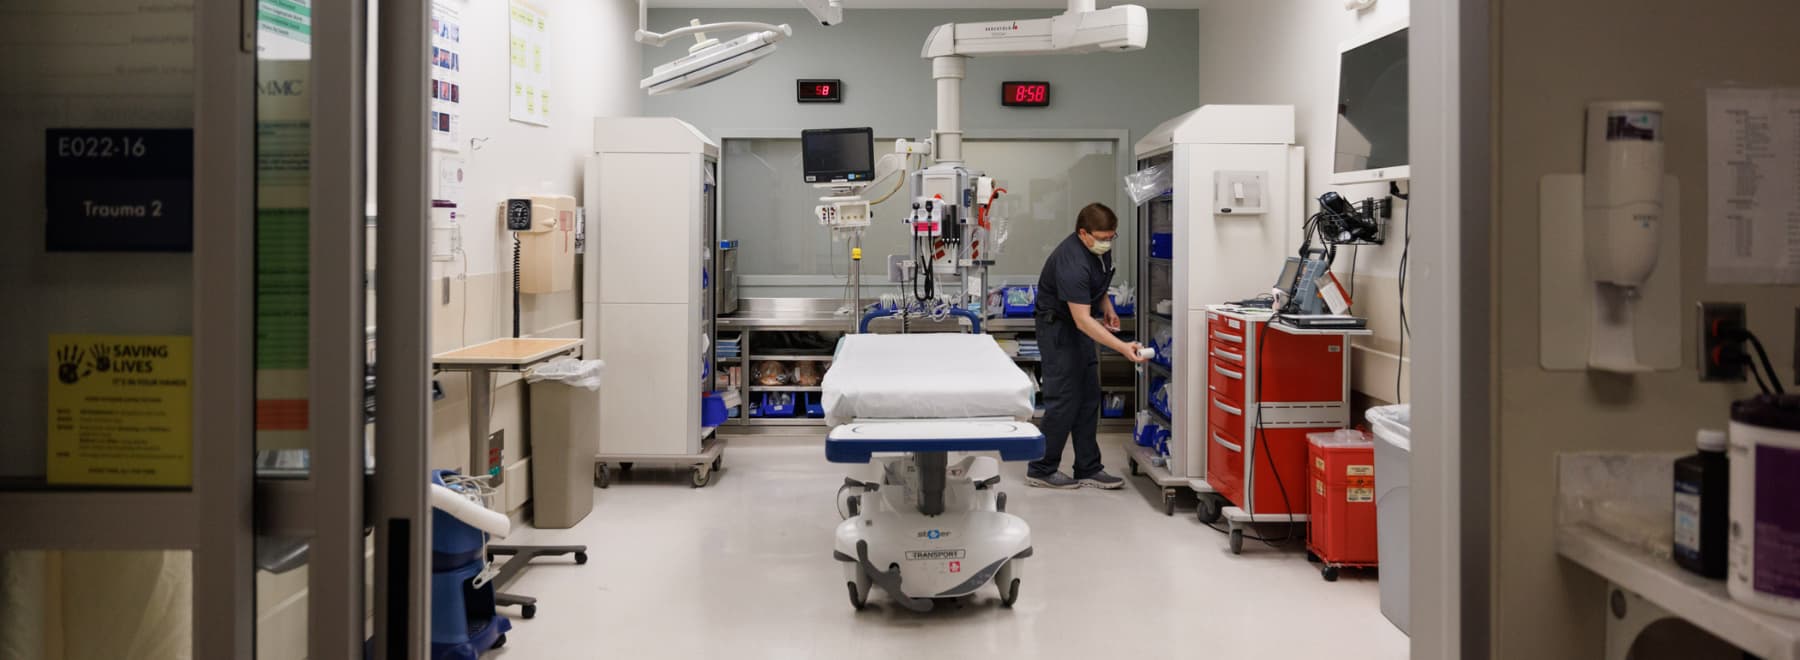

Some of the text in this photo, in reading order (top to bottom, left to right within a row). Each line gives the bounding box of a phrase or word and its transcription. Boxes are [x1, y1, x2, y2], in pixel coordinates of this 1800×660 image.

[1015, 85, 1045, 102] 8:58
[58, 136, 146, 157] E022-16
[83, 199, 163, 217] Trauma 2
[113, 345, 168, 358] SAVING
[113, 360, 153, 373] LIVES
[914, 551, 957, 559] TRANSPORT
